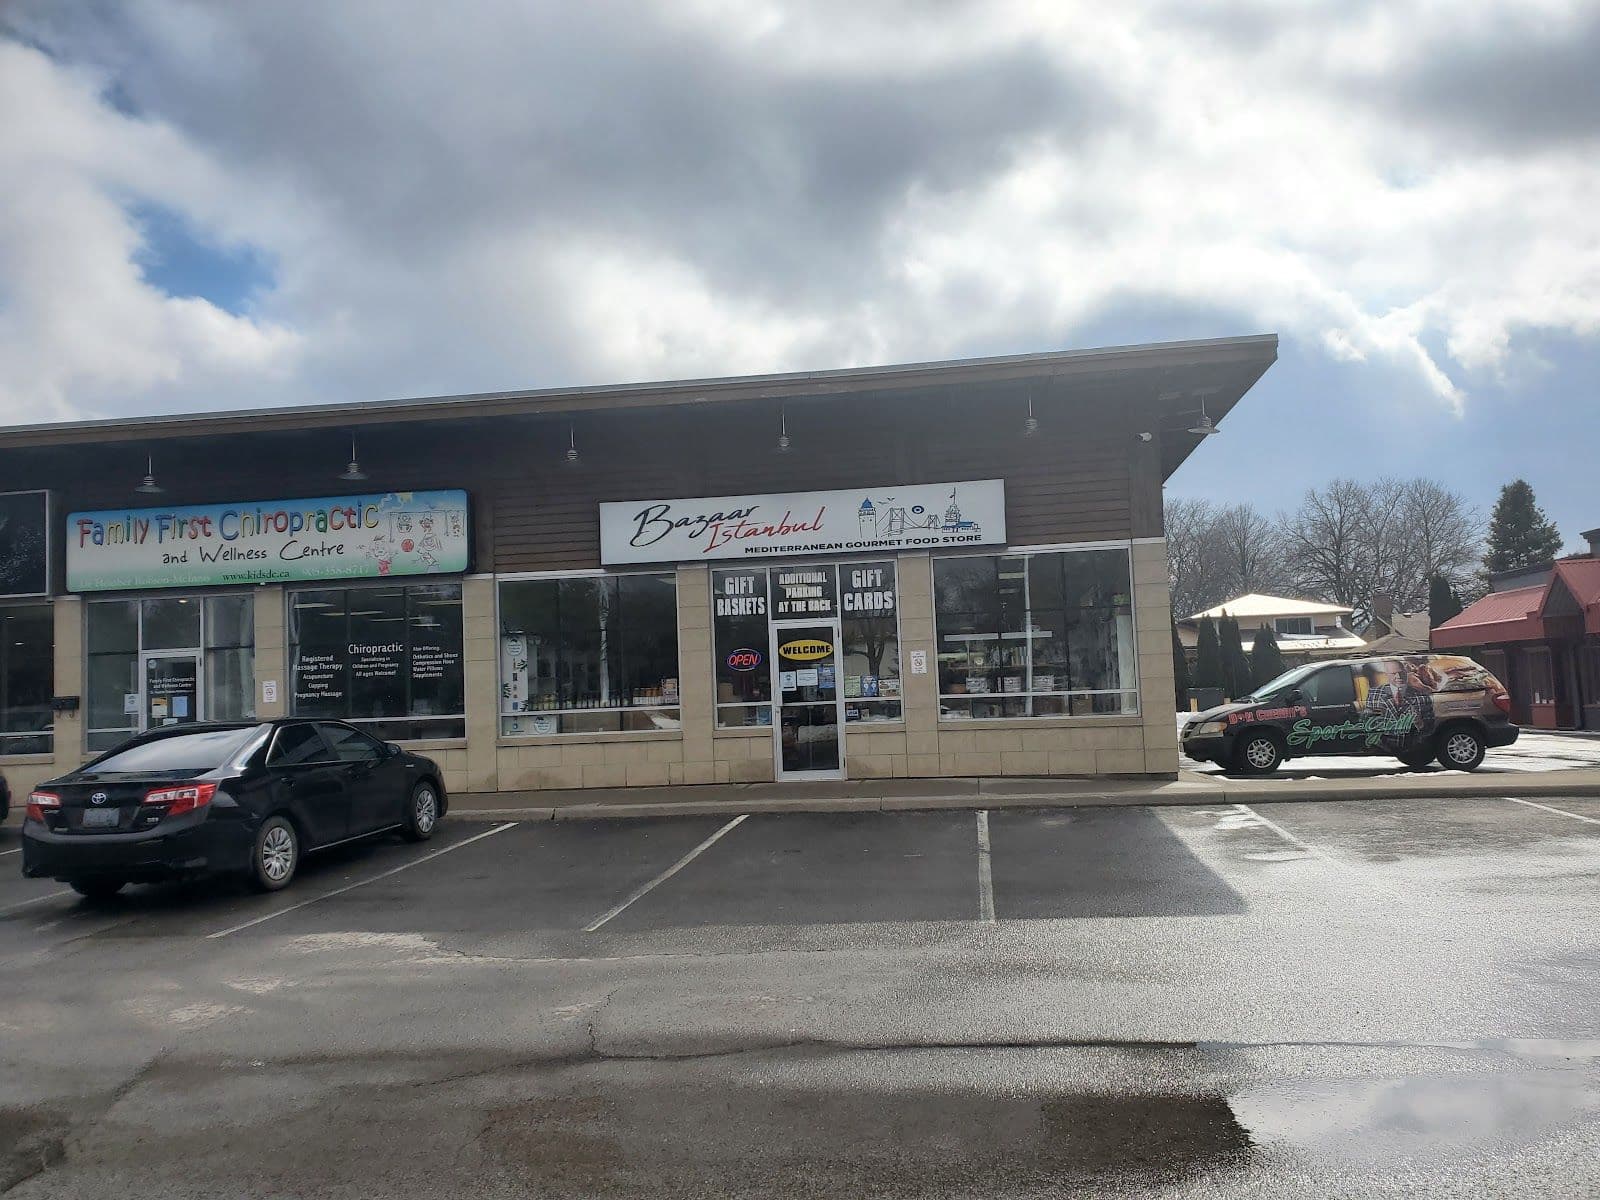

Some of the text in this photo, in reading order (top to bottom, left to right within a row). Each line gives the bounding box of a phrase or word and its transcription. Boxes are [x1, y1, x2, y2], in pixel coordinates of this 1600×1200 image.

[77, 501, 379, 548] Family First Chiropractic
[629, 504, 759, 547] Bazaar
[703, 506, 826, 553] Istanbul
[163, 540, 344, 564] and Wellness Centre
[745, 535, 982, 553] MEDITERRANEAN GOURMET FOOD STORE
[725, 576, 755, 595] GIFT
[779, 572, 827, 584] ADDITIONAL
[852, 568, 882, 588] GIFT
[785, 586, 822, 598] PARKING
[844, 591, 894, 611] CARDS
[717, 597, 765, 616] BASKETS
[778, 599, 831, 612] AT THE BACK
[348, 642, 404, 655] Chiropractic
[783, 646, 831, 655] WELCOME
[302, 655, 334, 664] Registered
[319, 663, 343, 671] Therapy
[729, 653, 758, 666] OPEN
[1287, 711, 1417, 749] Sports Grill
